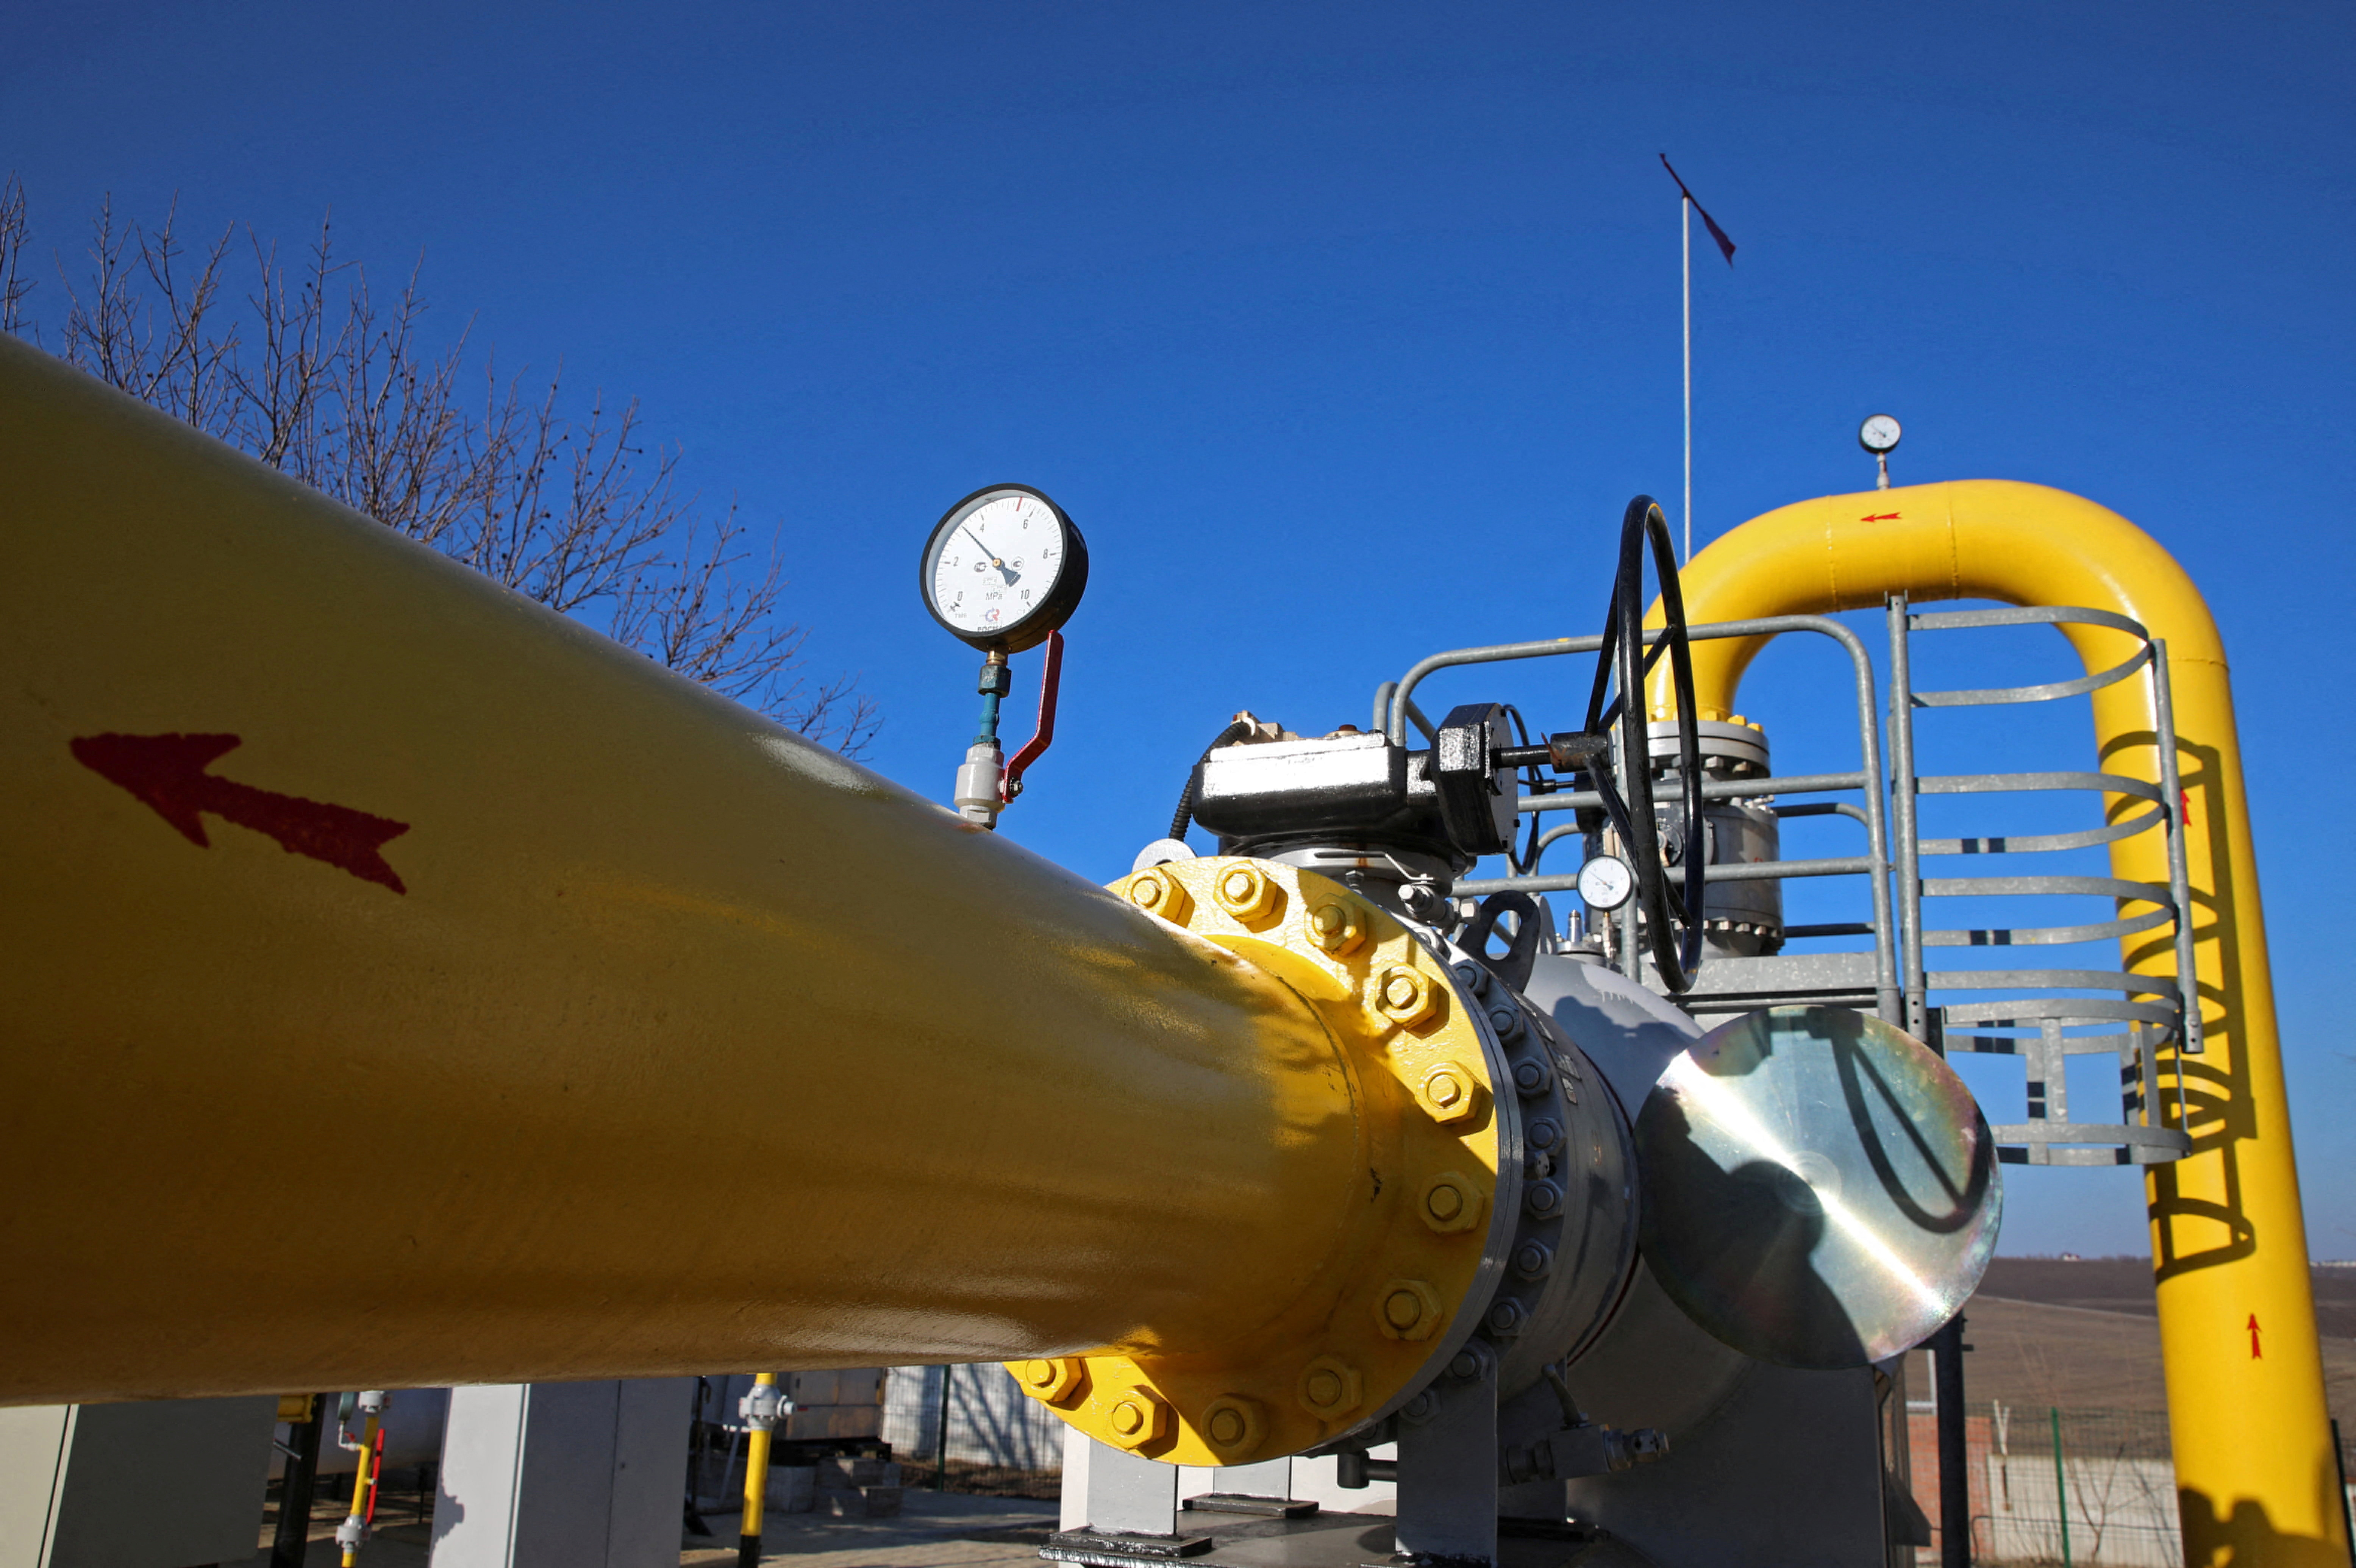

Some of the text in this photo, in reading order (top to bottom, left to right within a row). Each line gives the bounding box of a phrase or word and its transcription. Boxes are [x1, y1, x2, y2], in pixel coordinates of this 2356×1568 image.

[980, 523, 984, 533] 4
[1023, 519, 1028, 529] 6
[1043, 548, 1048, 559] 8
[953, 557, 959, 567] 2
[958, 590, 963, 601] 0
[985, 592, 1003, 600] MPa
[1021, 589, 1030, 600] 10
